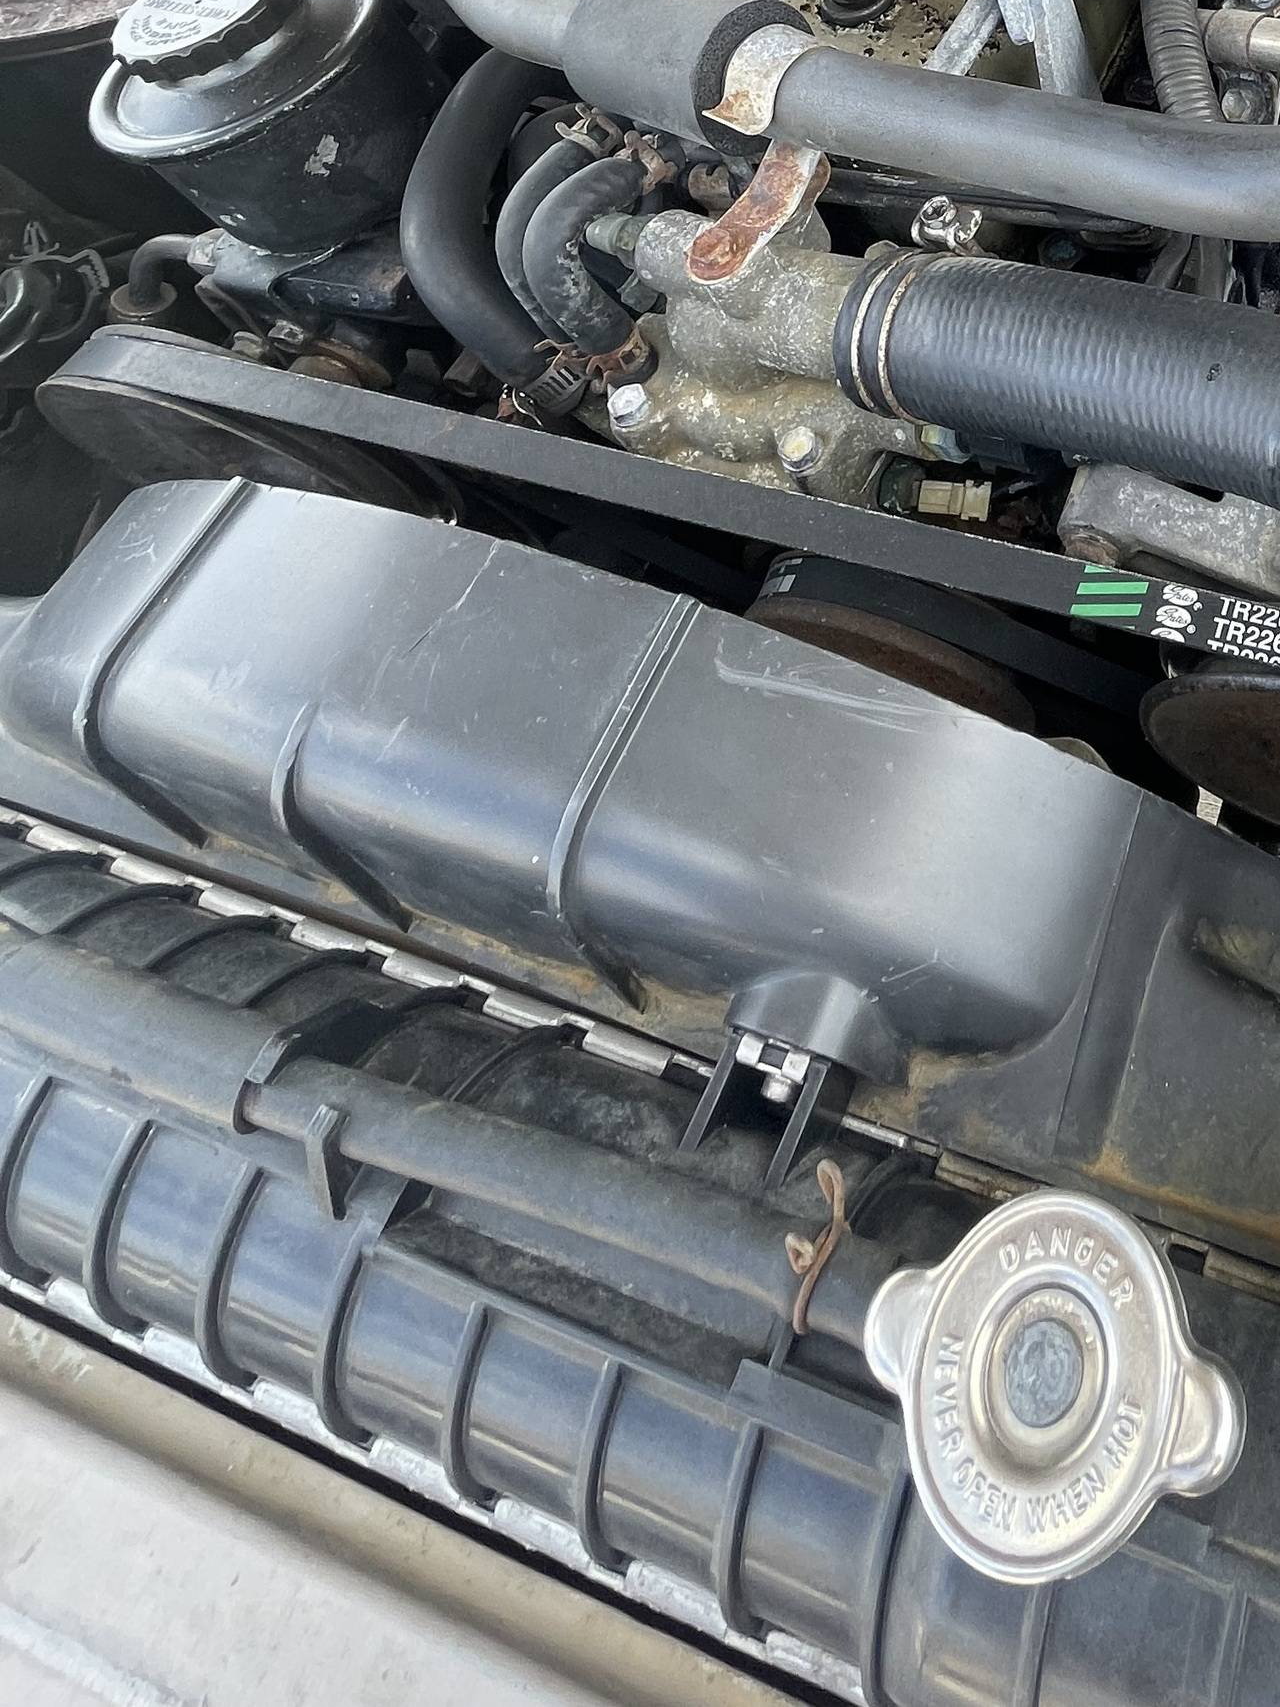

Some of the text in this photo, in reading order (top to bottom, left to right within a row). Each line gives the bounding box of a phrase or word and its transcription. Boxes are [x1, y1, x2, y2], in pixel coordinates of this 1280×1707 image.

[998, 1227, 1134, 1311] DANGER
[930, 1333, 1144, 1535] NEVER OPEN WHEN HOT
